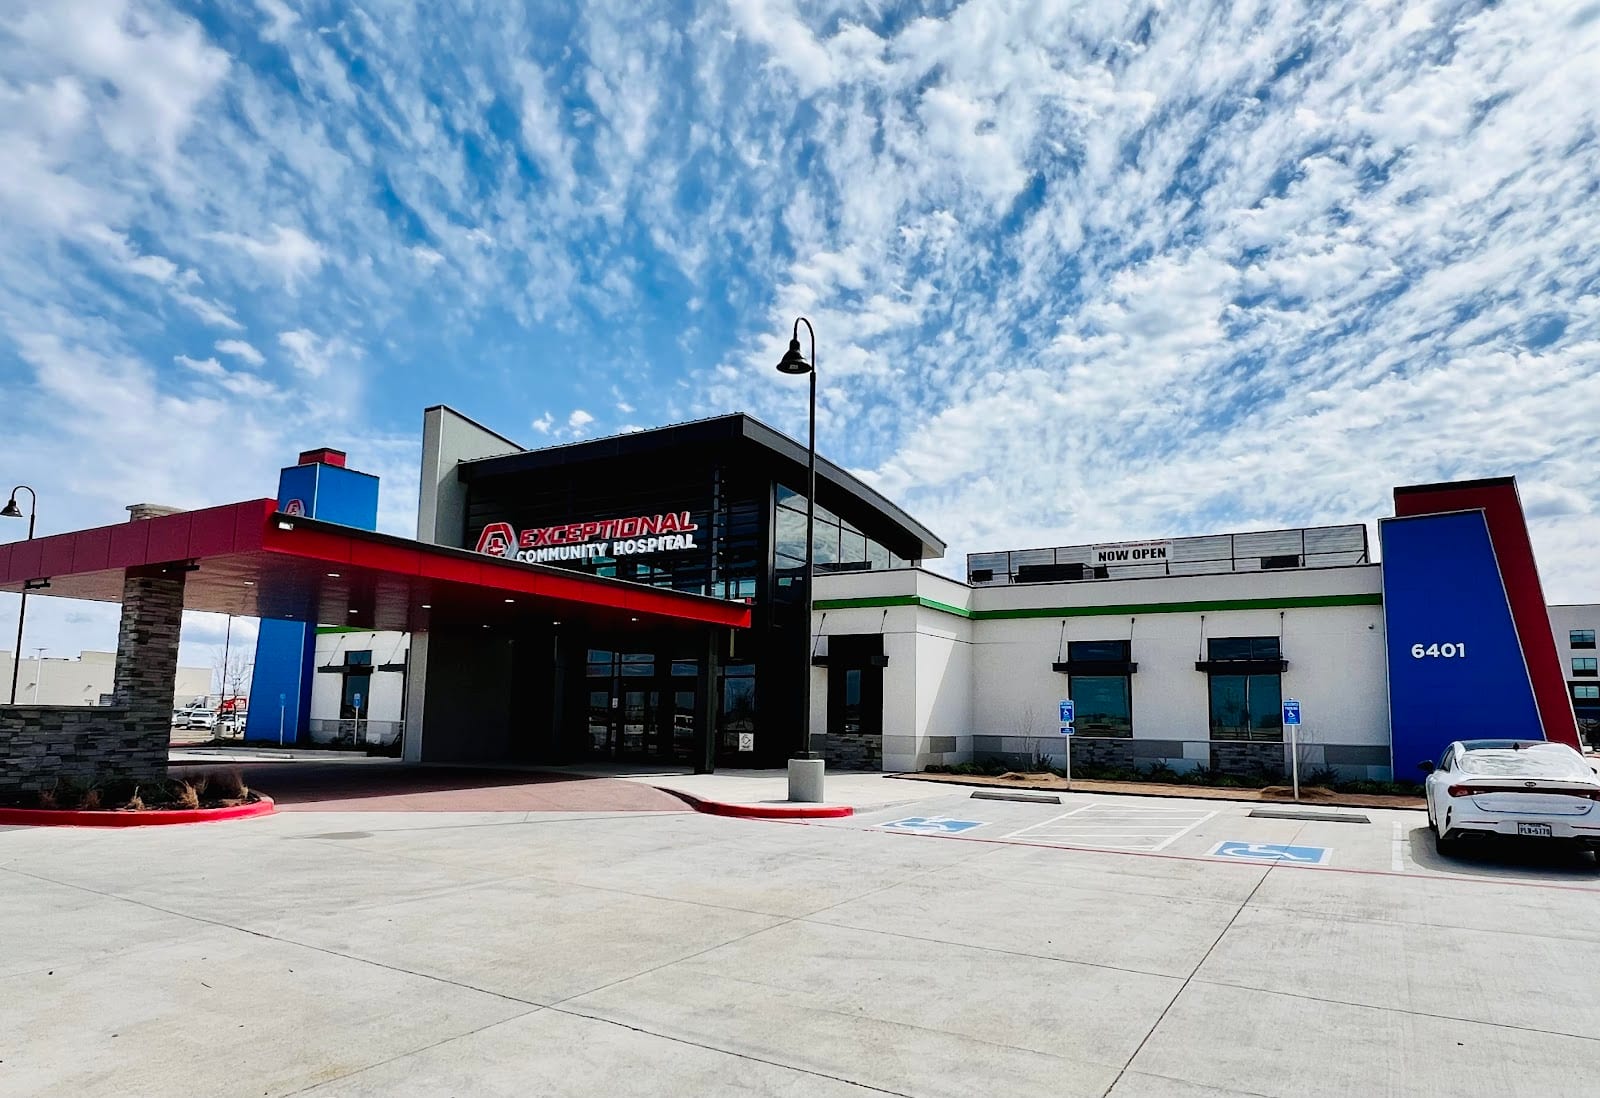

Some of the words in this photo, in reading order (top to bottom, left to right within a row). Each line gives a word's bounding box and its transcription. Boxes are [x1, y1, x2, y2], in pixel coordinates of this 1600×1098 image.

[519, 511, 698, 548] EXCEPTIONAL
[516, 542, 609, 563] COMMUNITY
[613, 534, 698, 555] HOSPITAL
[1098, 550, 1129, 561] NOW
[1132, 547, 1166, 560] OPEN
[1411, 642, 1465, 659] 6401
